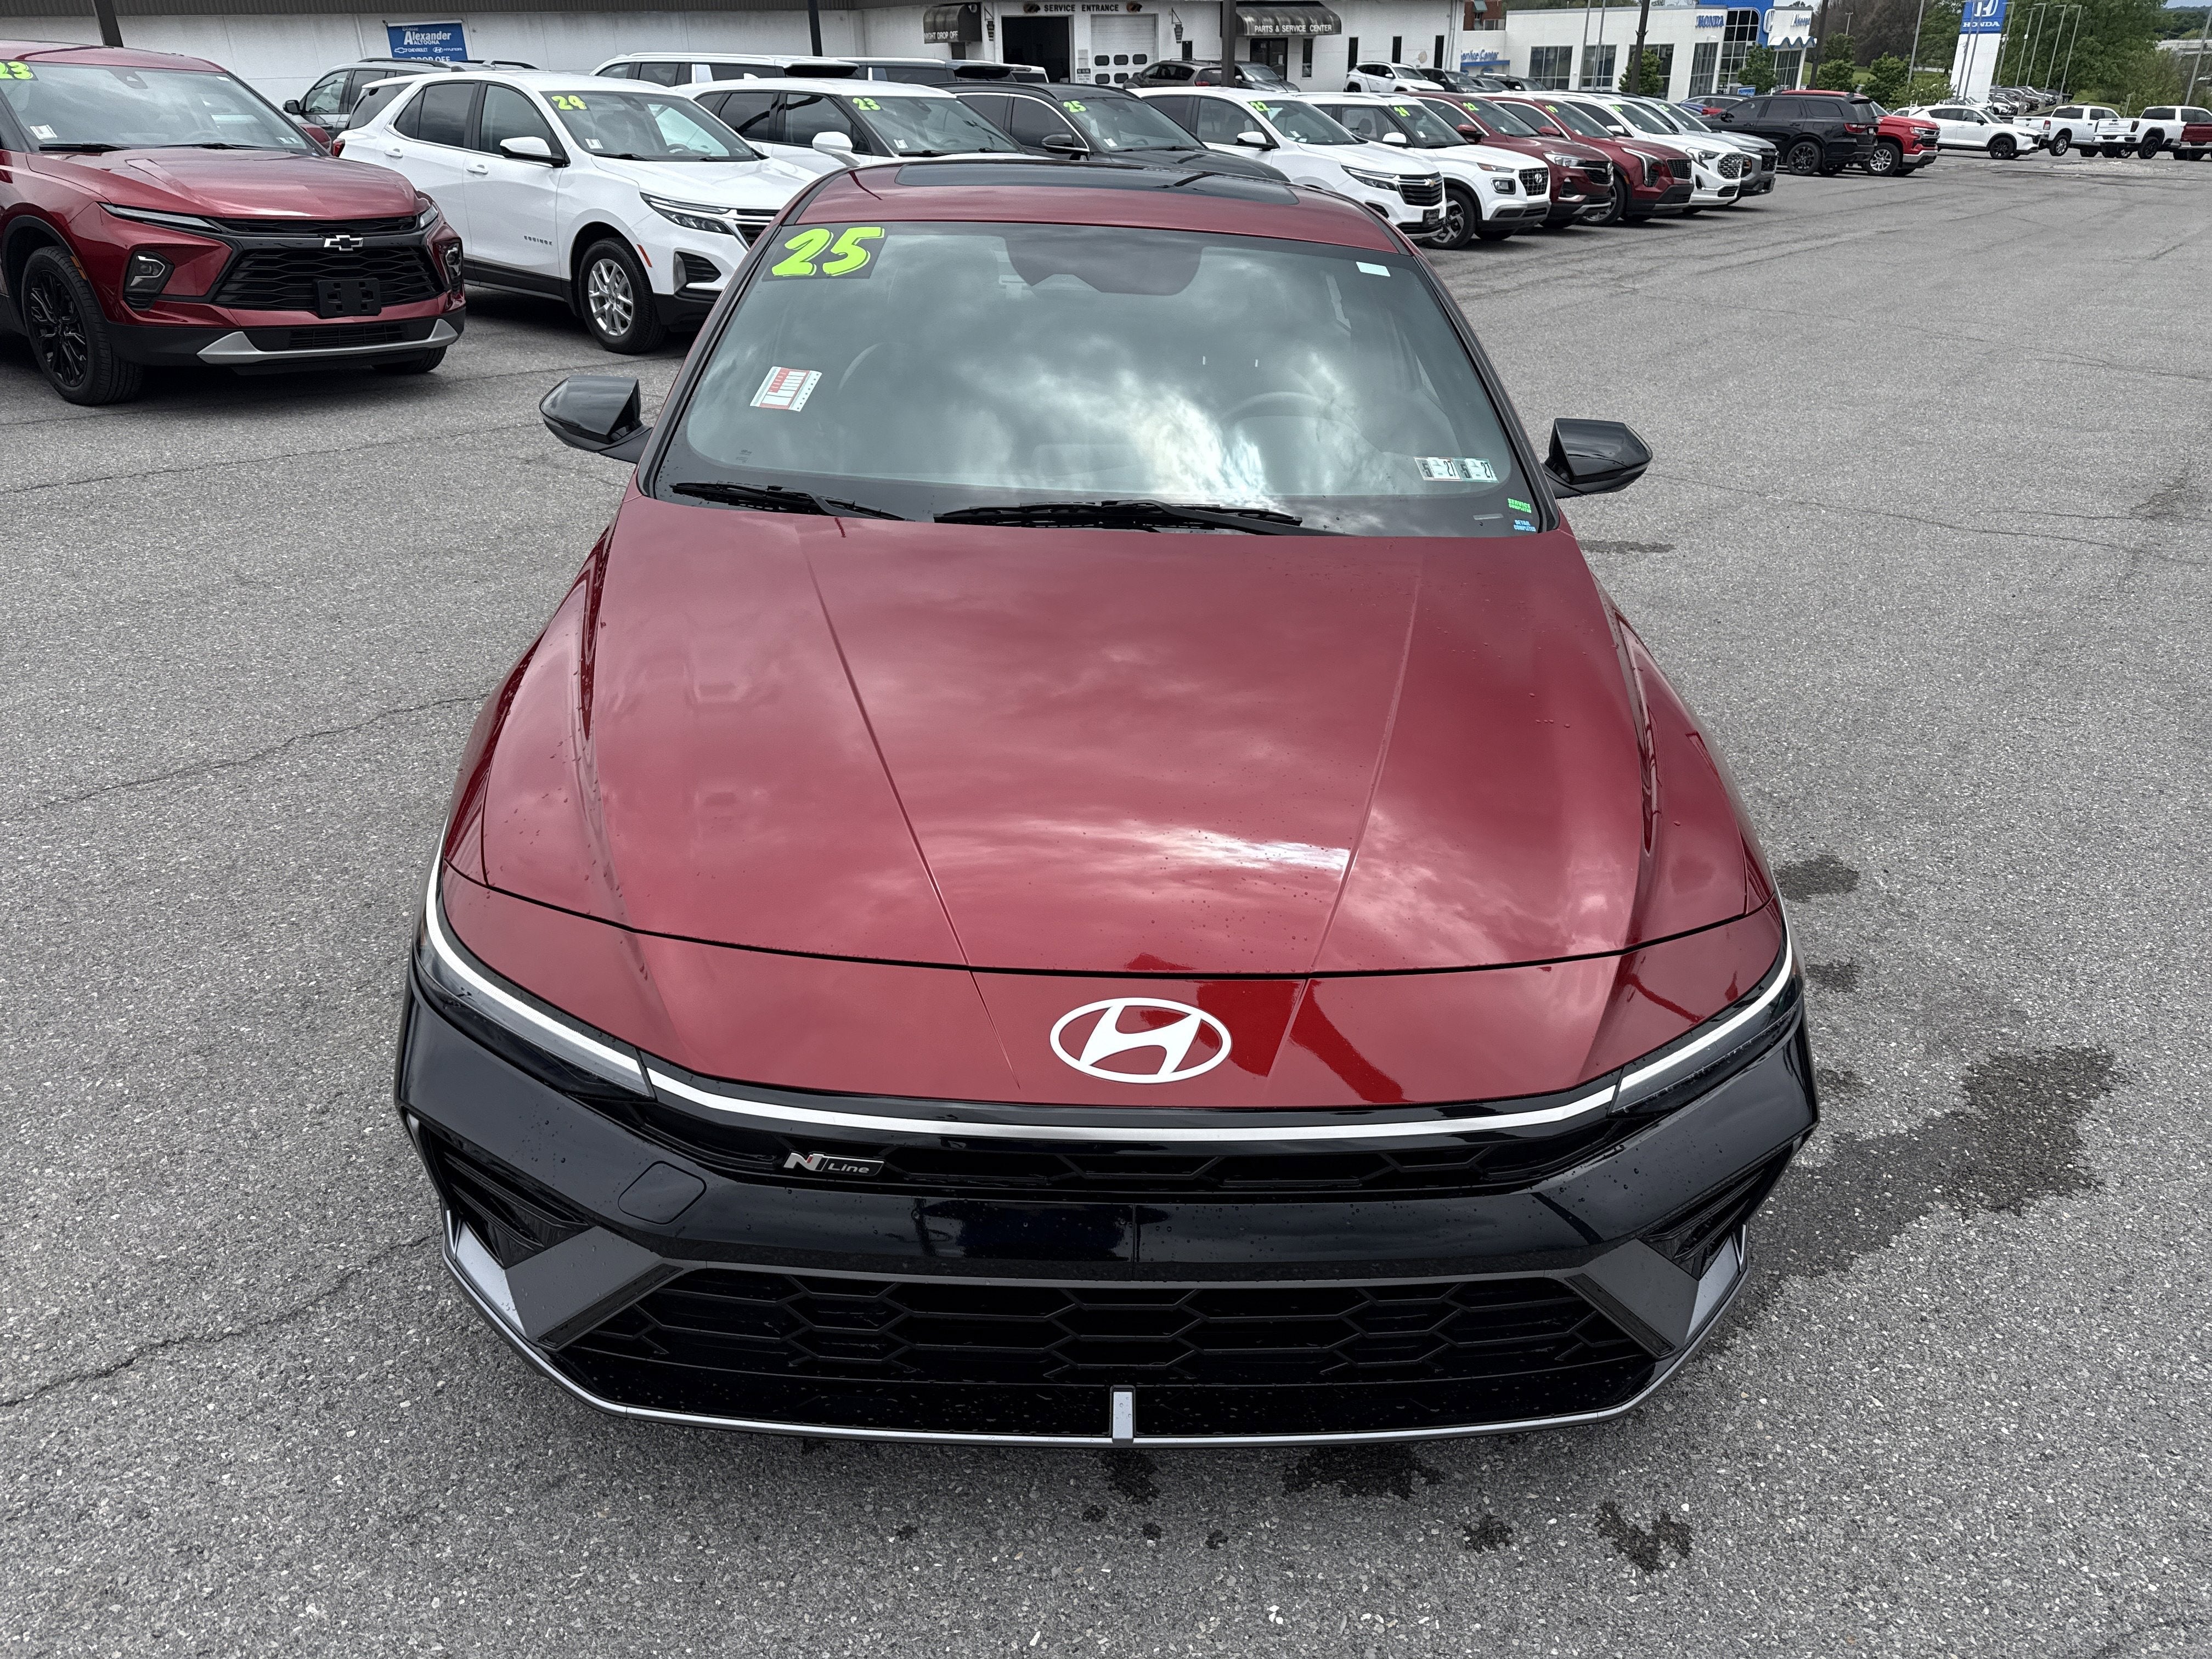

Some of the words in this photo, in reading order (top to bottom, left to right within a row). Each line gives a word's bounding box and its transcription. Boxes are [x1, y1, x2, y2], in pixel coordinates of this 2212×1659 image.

[404, 31, 452, 45] Alexander
[949, 30, 958, 38] OFF
[551, 95, 587, 110] 24
[852, 98, 881, 110] 23
[1063, 100, 1086, 113] 25
[524, 235, 552, 246] EQUINOX
[772, 227, 885, 276] 25
[1422, 462, 1433, 477] 5
[1443, 460, 1456, 478] 27
[1460, 464, 1471, 478] 5
[1480, 462, 1493, 479] 27
[1508, 498, 1531, 510] SERVICE
[783, 1152, 824, 1172] N
[827, 1163, 870, 1173] Line
